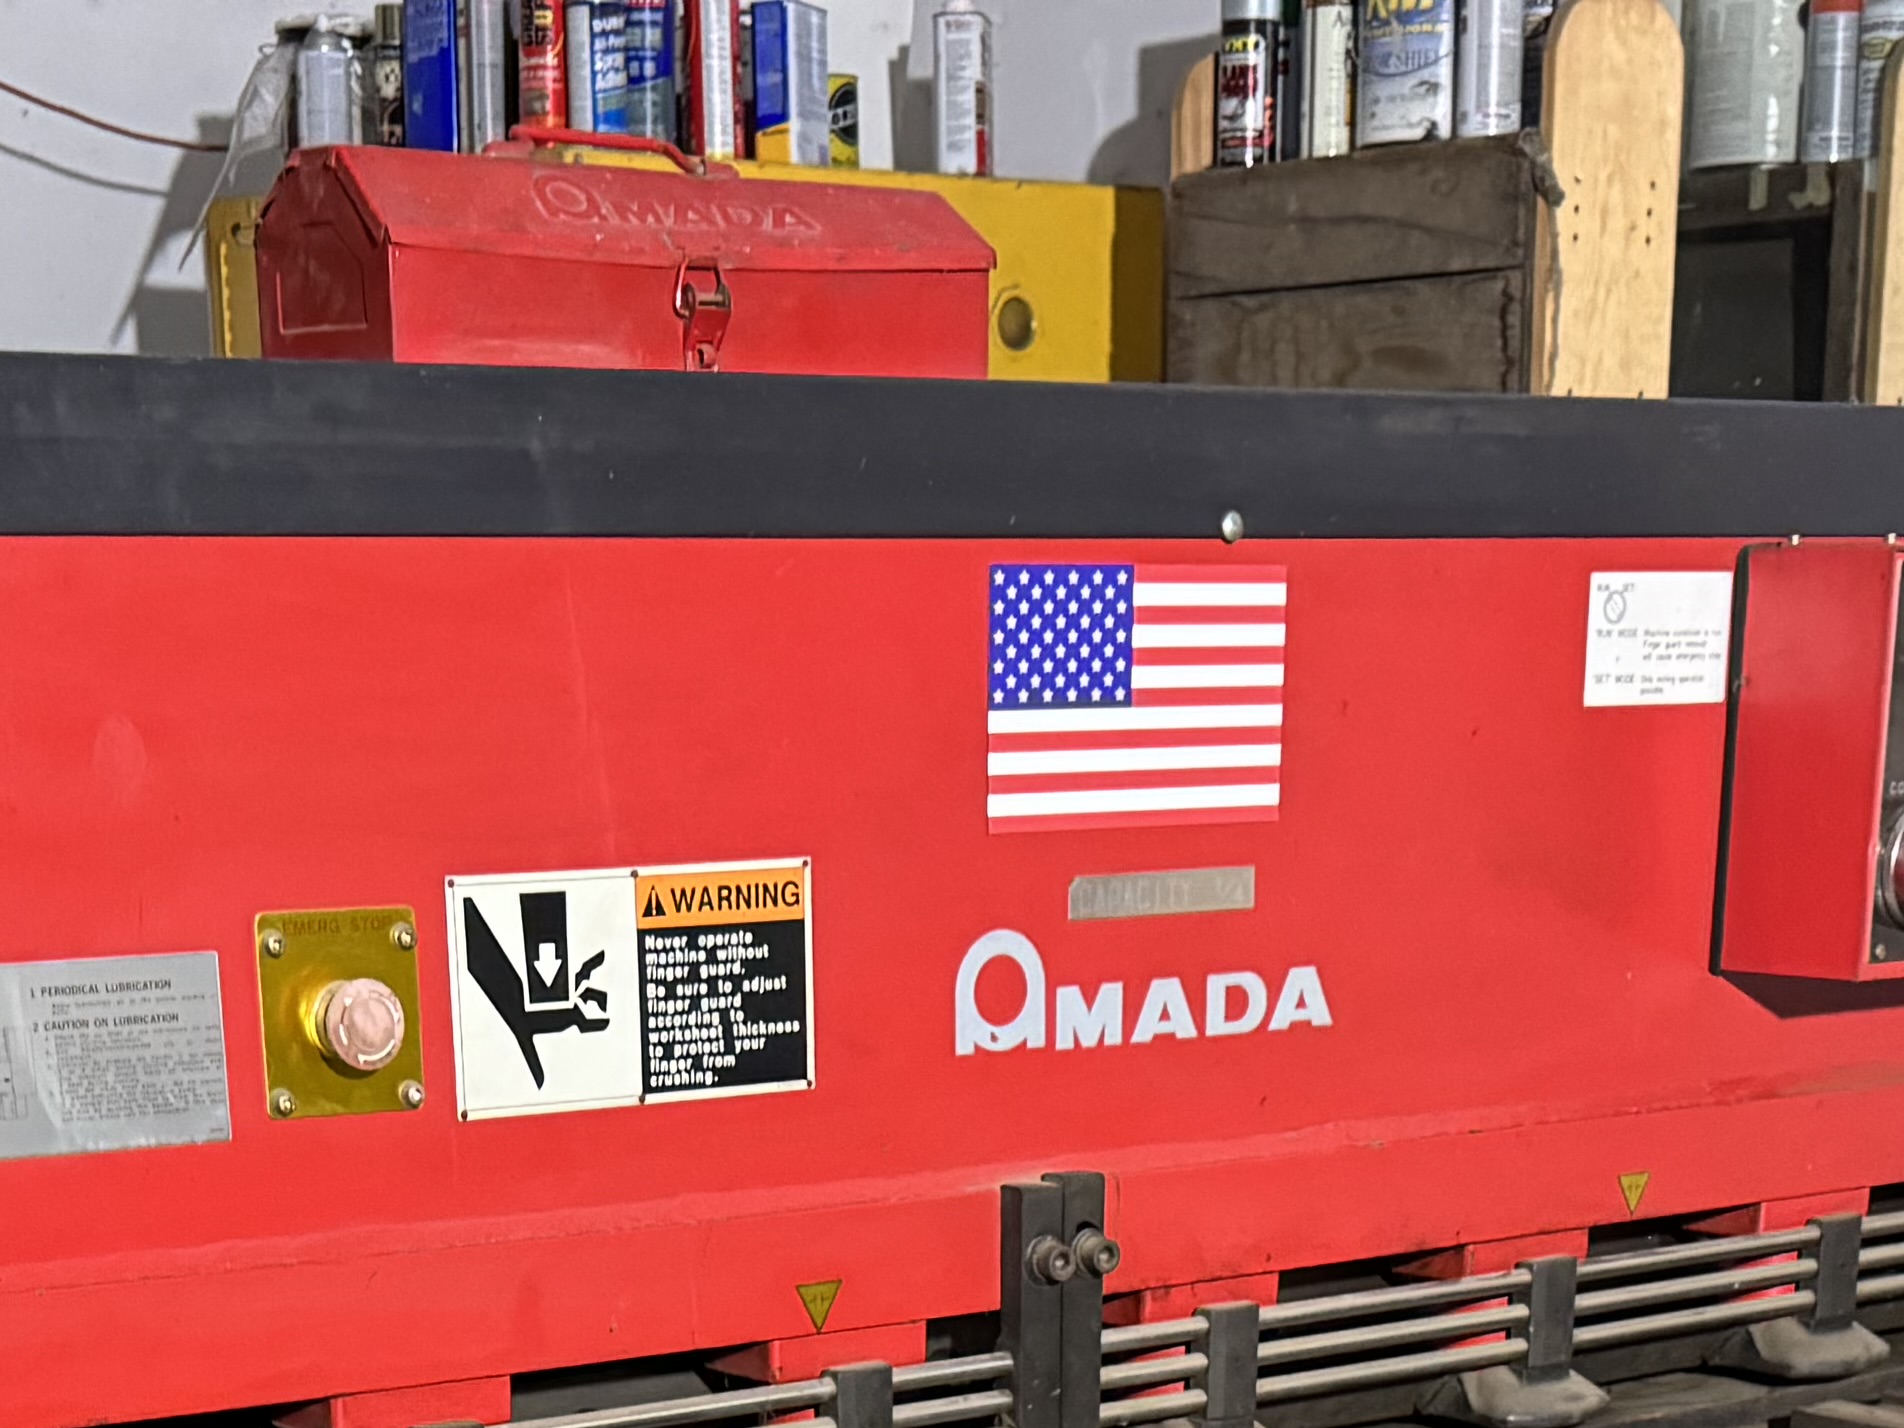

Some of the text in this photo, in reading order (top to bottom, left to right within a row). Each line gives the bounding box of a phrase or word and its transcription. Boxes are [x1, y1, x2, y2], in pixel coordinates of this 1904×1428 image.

[670, 880, 800, 913] WARNING
[645, 930, 753, 951] Never operate
[645, 944, 769, 966] machine without
[646, 965, 690, 981] finger
[40, 983, 100, 997] PERIODICAL
[105, 979, 172, 994] LUBRICATION
[646, 975, 787, 998] Be sure to adjust
[955, 927, 1334, 1057] AMADA
[647, 992, 742, 1014] finger guard
[44, 1017, 89, 1032] CAUTION
[93, 1016, 109, 1028] ON
[113, 1012, 179, 1028] LUBRICATION
[648, 1008, 745, 1029] according to
[733, 1020, 801, 1038] thickness
[649, 1036, 766, 1058] to protect your
[650, 1054, 736, 1073] finger from
